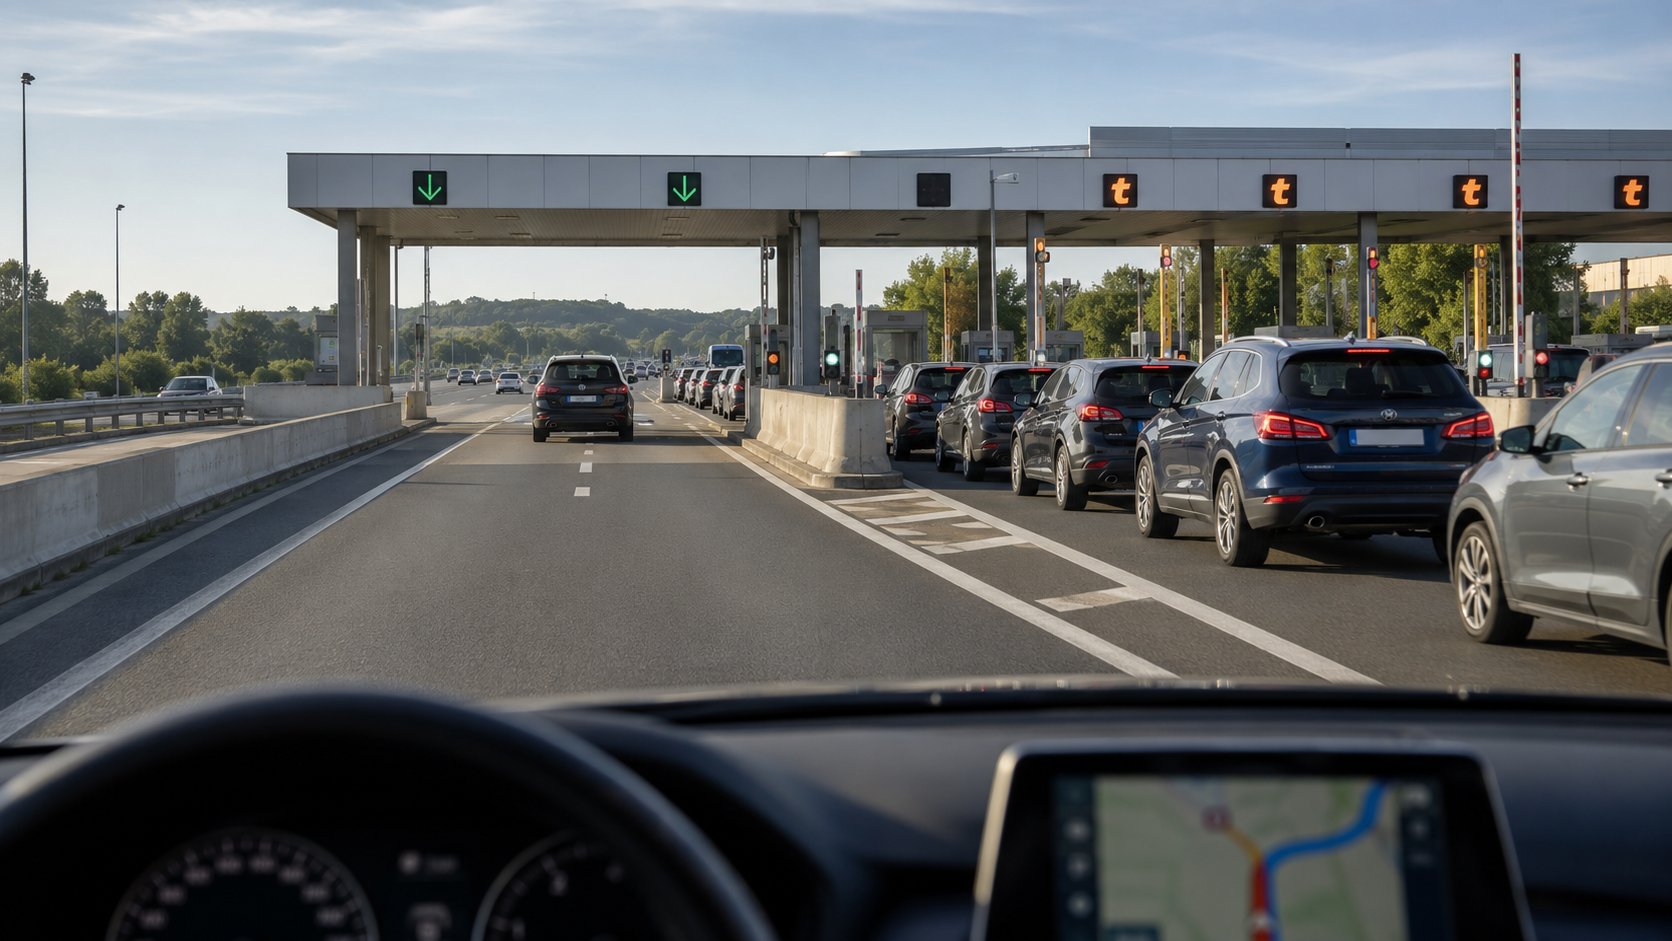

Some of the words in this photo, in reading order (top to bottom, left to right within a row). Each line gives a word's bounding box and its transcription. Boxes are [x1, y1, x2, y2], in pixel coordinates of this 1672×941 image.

[1111, 177, 1131, 205] t
[1271, 177, 1291, 205] t
[1461, 178, 1481, 206] t
[1622, 179, 1643, 206] t
